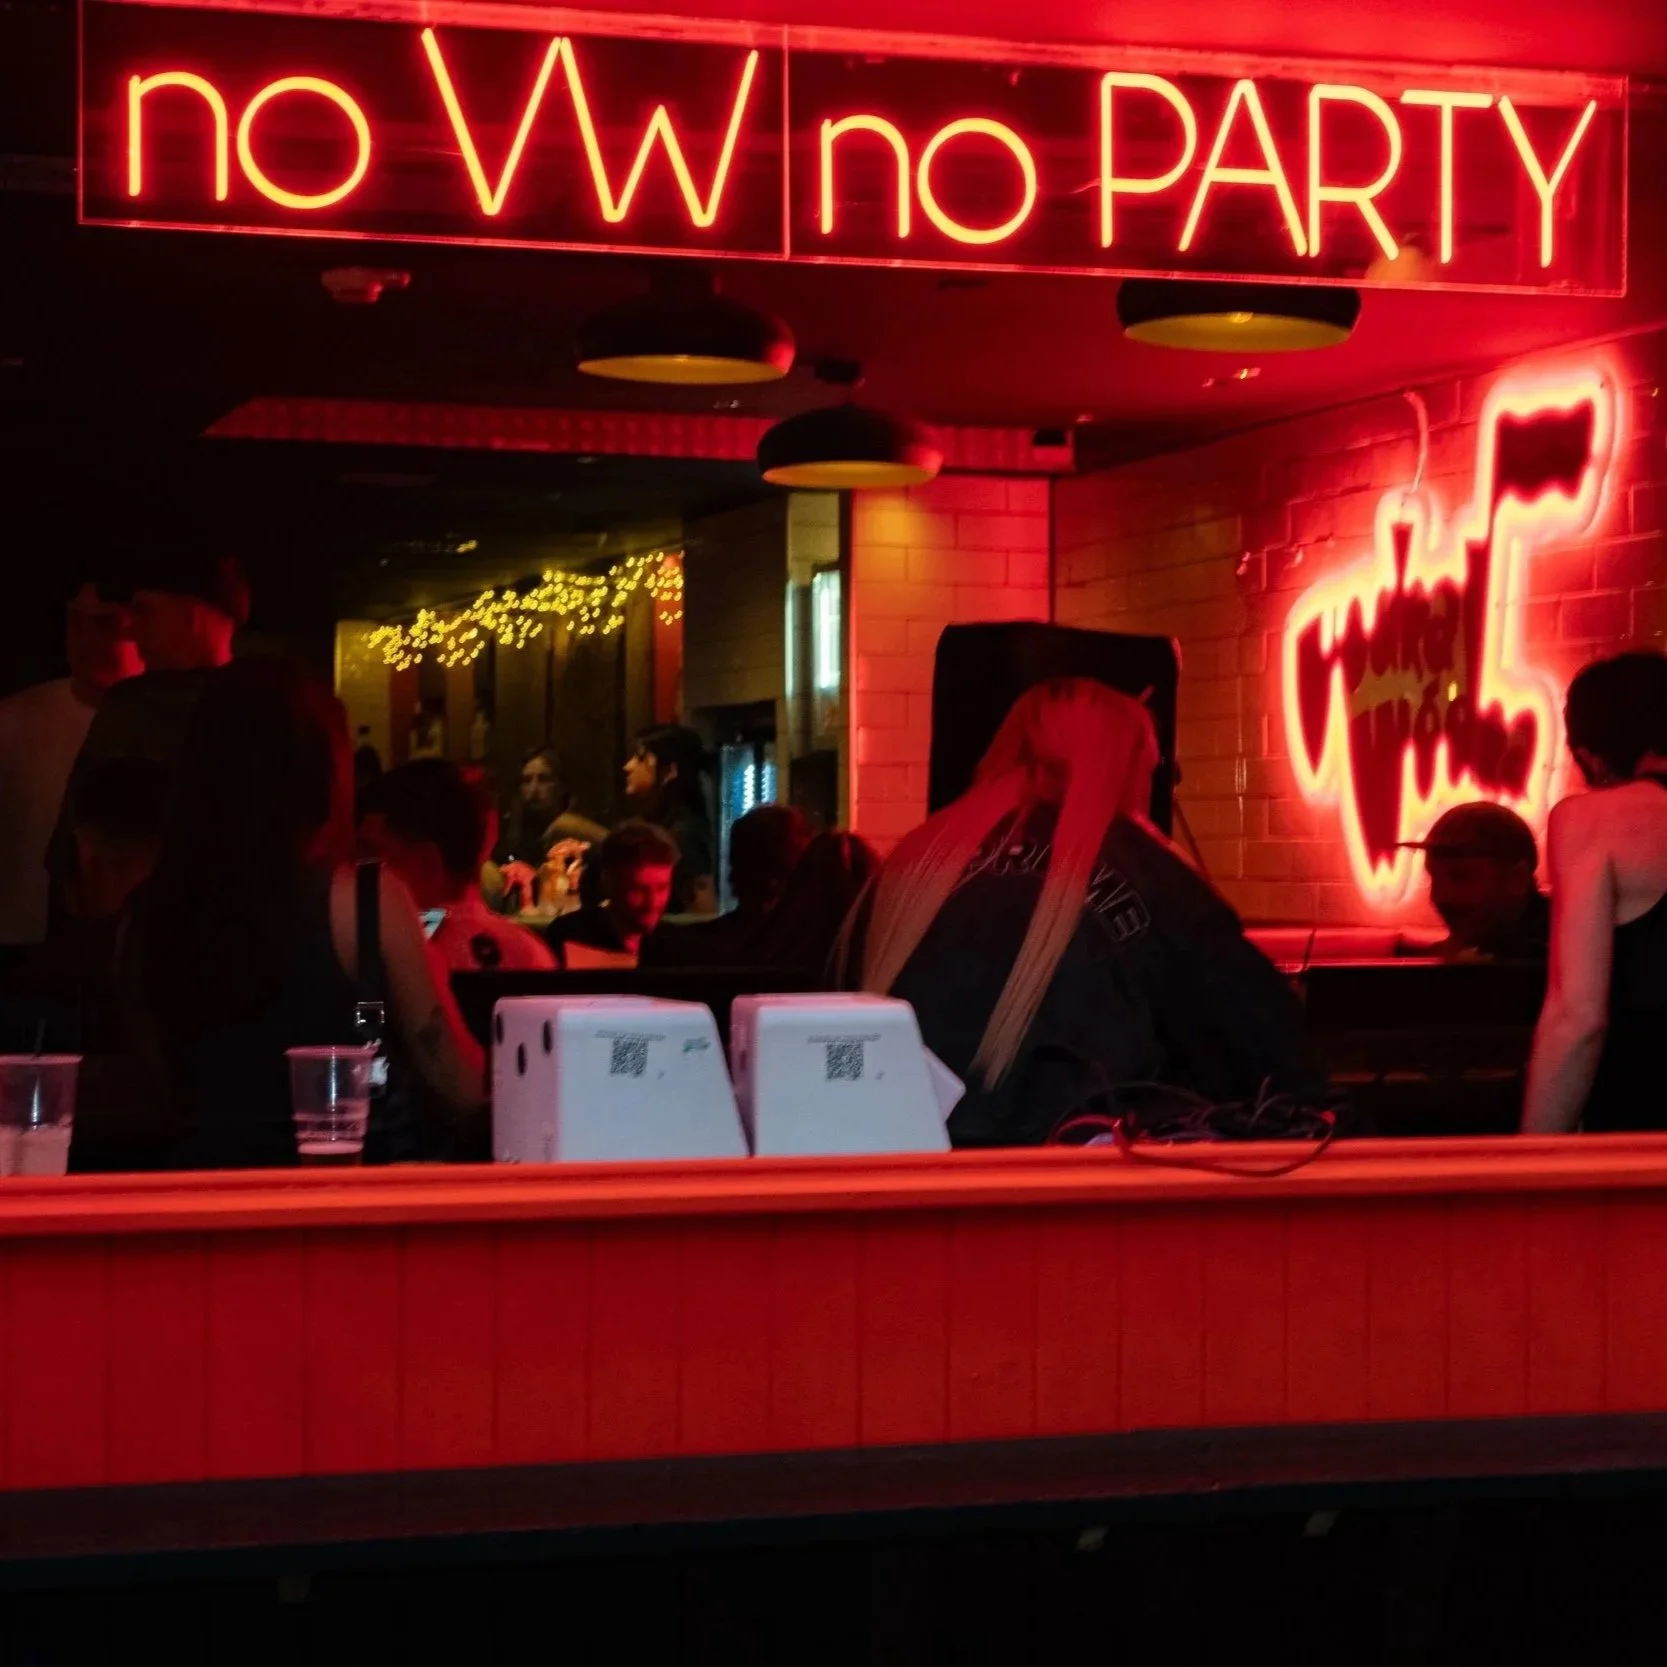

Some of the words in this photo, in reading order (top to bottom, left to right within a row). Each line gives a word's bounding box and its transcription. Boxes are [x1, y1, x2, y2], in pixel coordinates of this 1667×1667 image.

[126, 70, 372, 210] no
[819, 114, 1038, 245] no
[1099, 70, 1598, 268] PARTY
